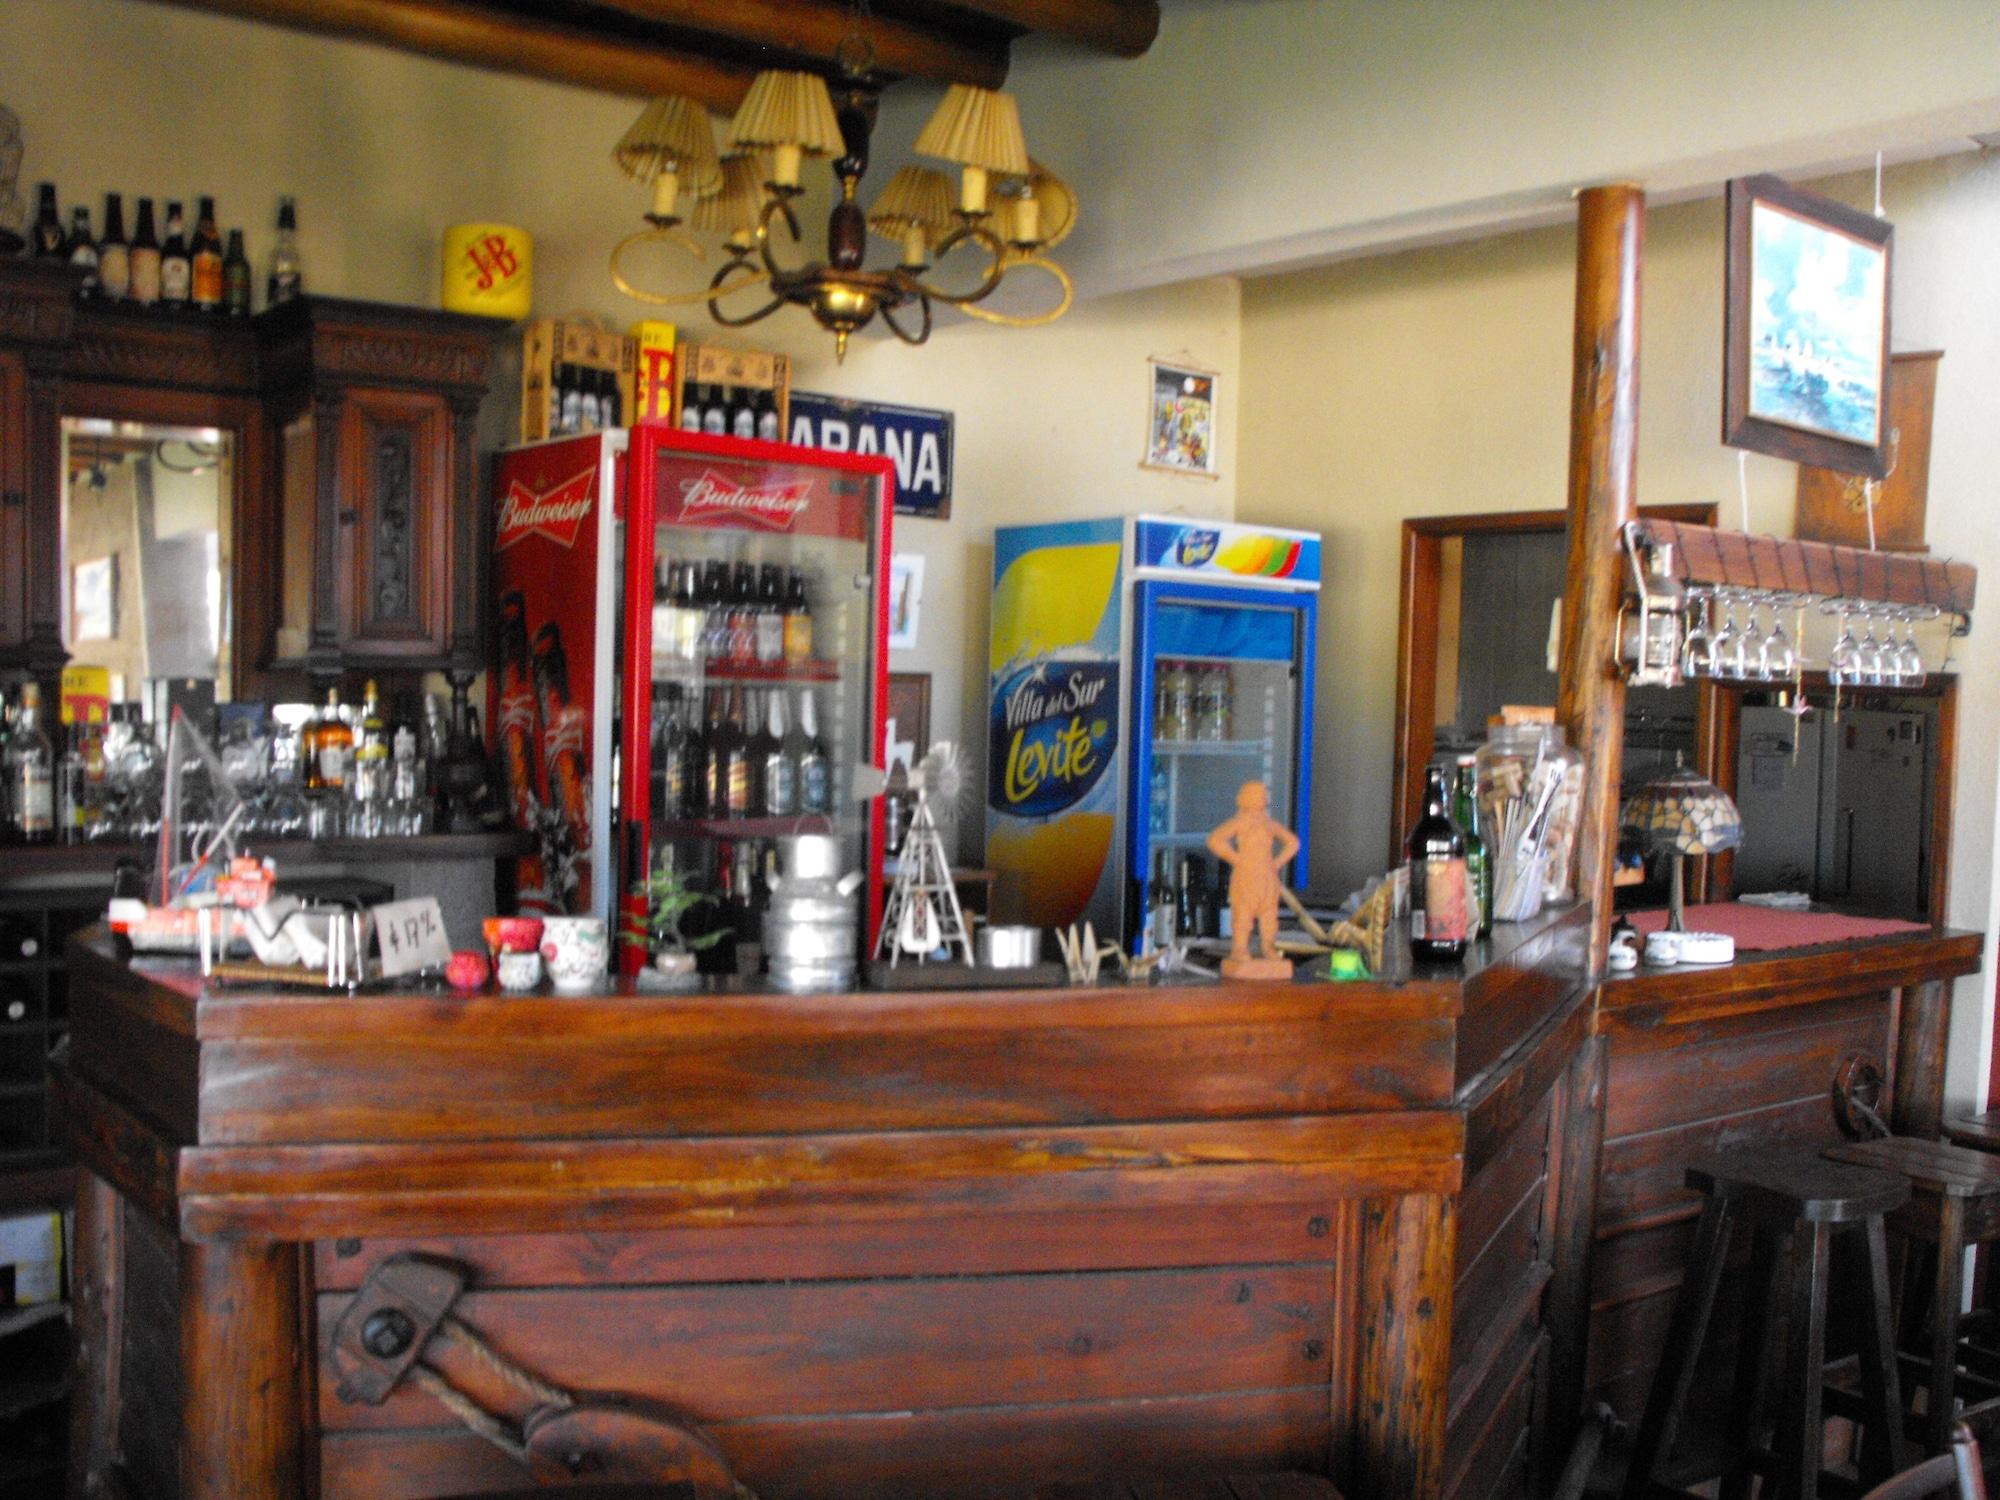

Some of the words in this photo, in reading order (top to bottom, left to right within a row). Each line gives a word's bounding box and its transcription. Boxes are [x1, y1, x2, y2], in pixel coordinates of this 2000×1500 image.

[497, 491, 593, 532] Budweiser
[1005, 676, 1044, 731] Villa
[1063, 671, 1105, 713] Sur
[1004, 716, 1097, 803] Levite
